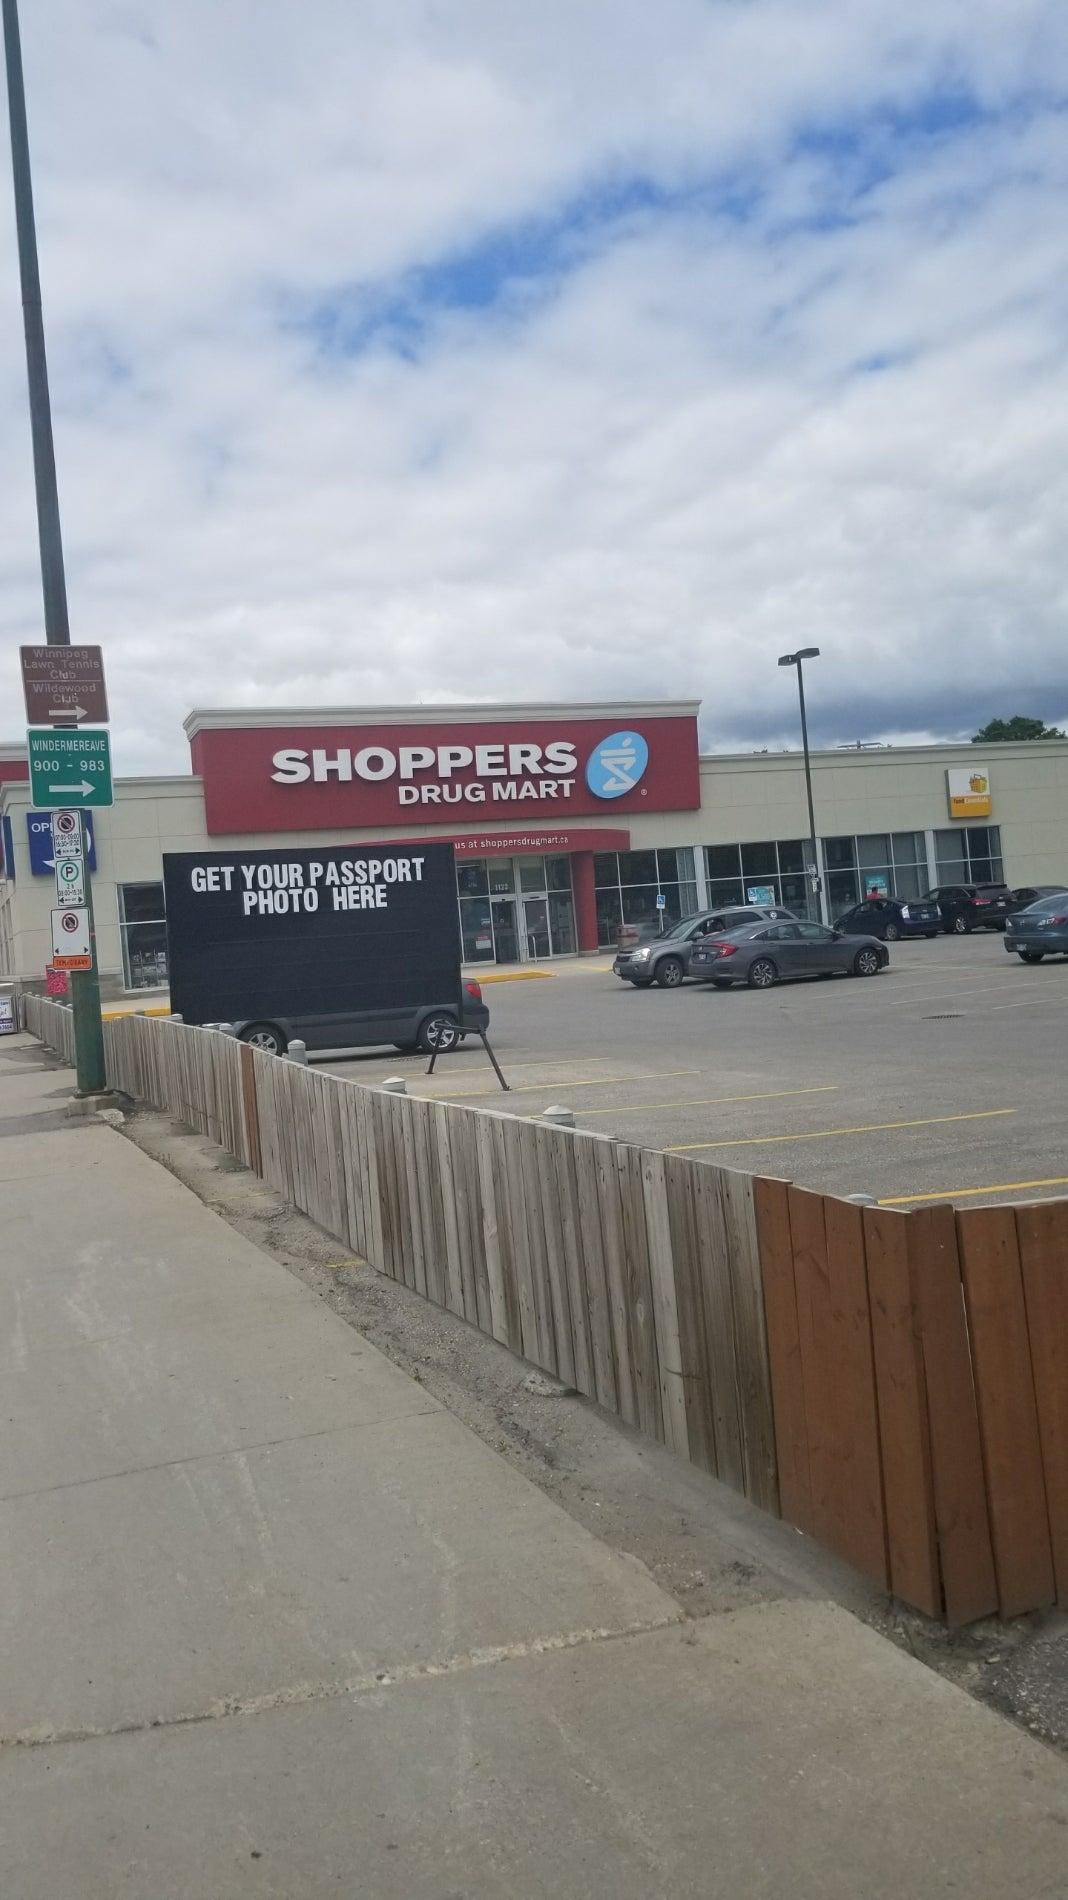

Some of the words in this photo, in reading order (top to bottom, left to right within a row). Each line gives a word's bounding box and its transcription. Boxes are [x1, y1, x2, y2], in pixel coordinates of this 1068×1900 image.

[33, 648, 89, 660] Winnipeg
[24, 659, 55, 669] Lawn
[61, 659, 100, 669] Tennis
[49, 669, 76, 680] Club
[52, 693, 79, 703] Club
[34, 760, 60, 772] 900
[80, 760, 105, 771] 983
[270, 741, 578, 784] SHOPPERS
[398, 782, 485, 805] DRUG
[492, 779, 576, 800] MART
[468, 840, 478, 848] at
[480, 836, 569, 848] shoppersdrugmart.ca
[65, 866, 74, 878] P
[191, 866, 235, 893] GET
[240, 863, 304, 890] YOUR
[309, 857, 425, 887] PASSPORT
[242, 887, 319, 916] PHOTO
[332, 883, 388, 912] HERE
